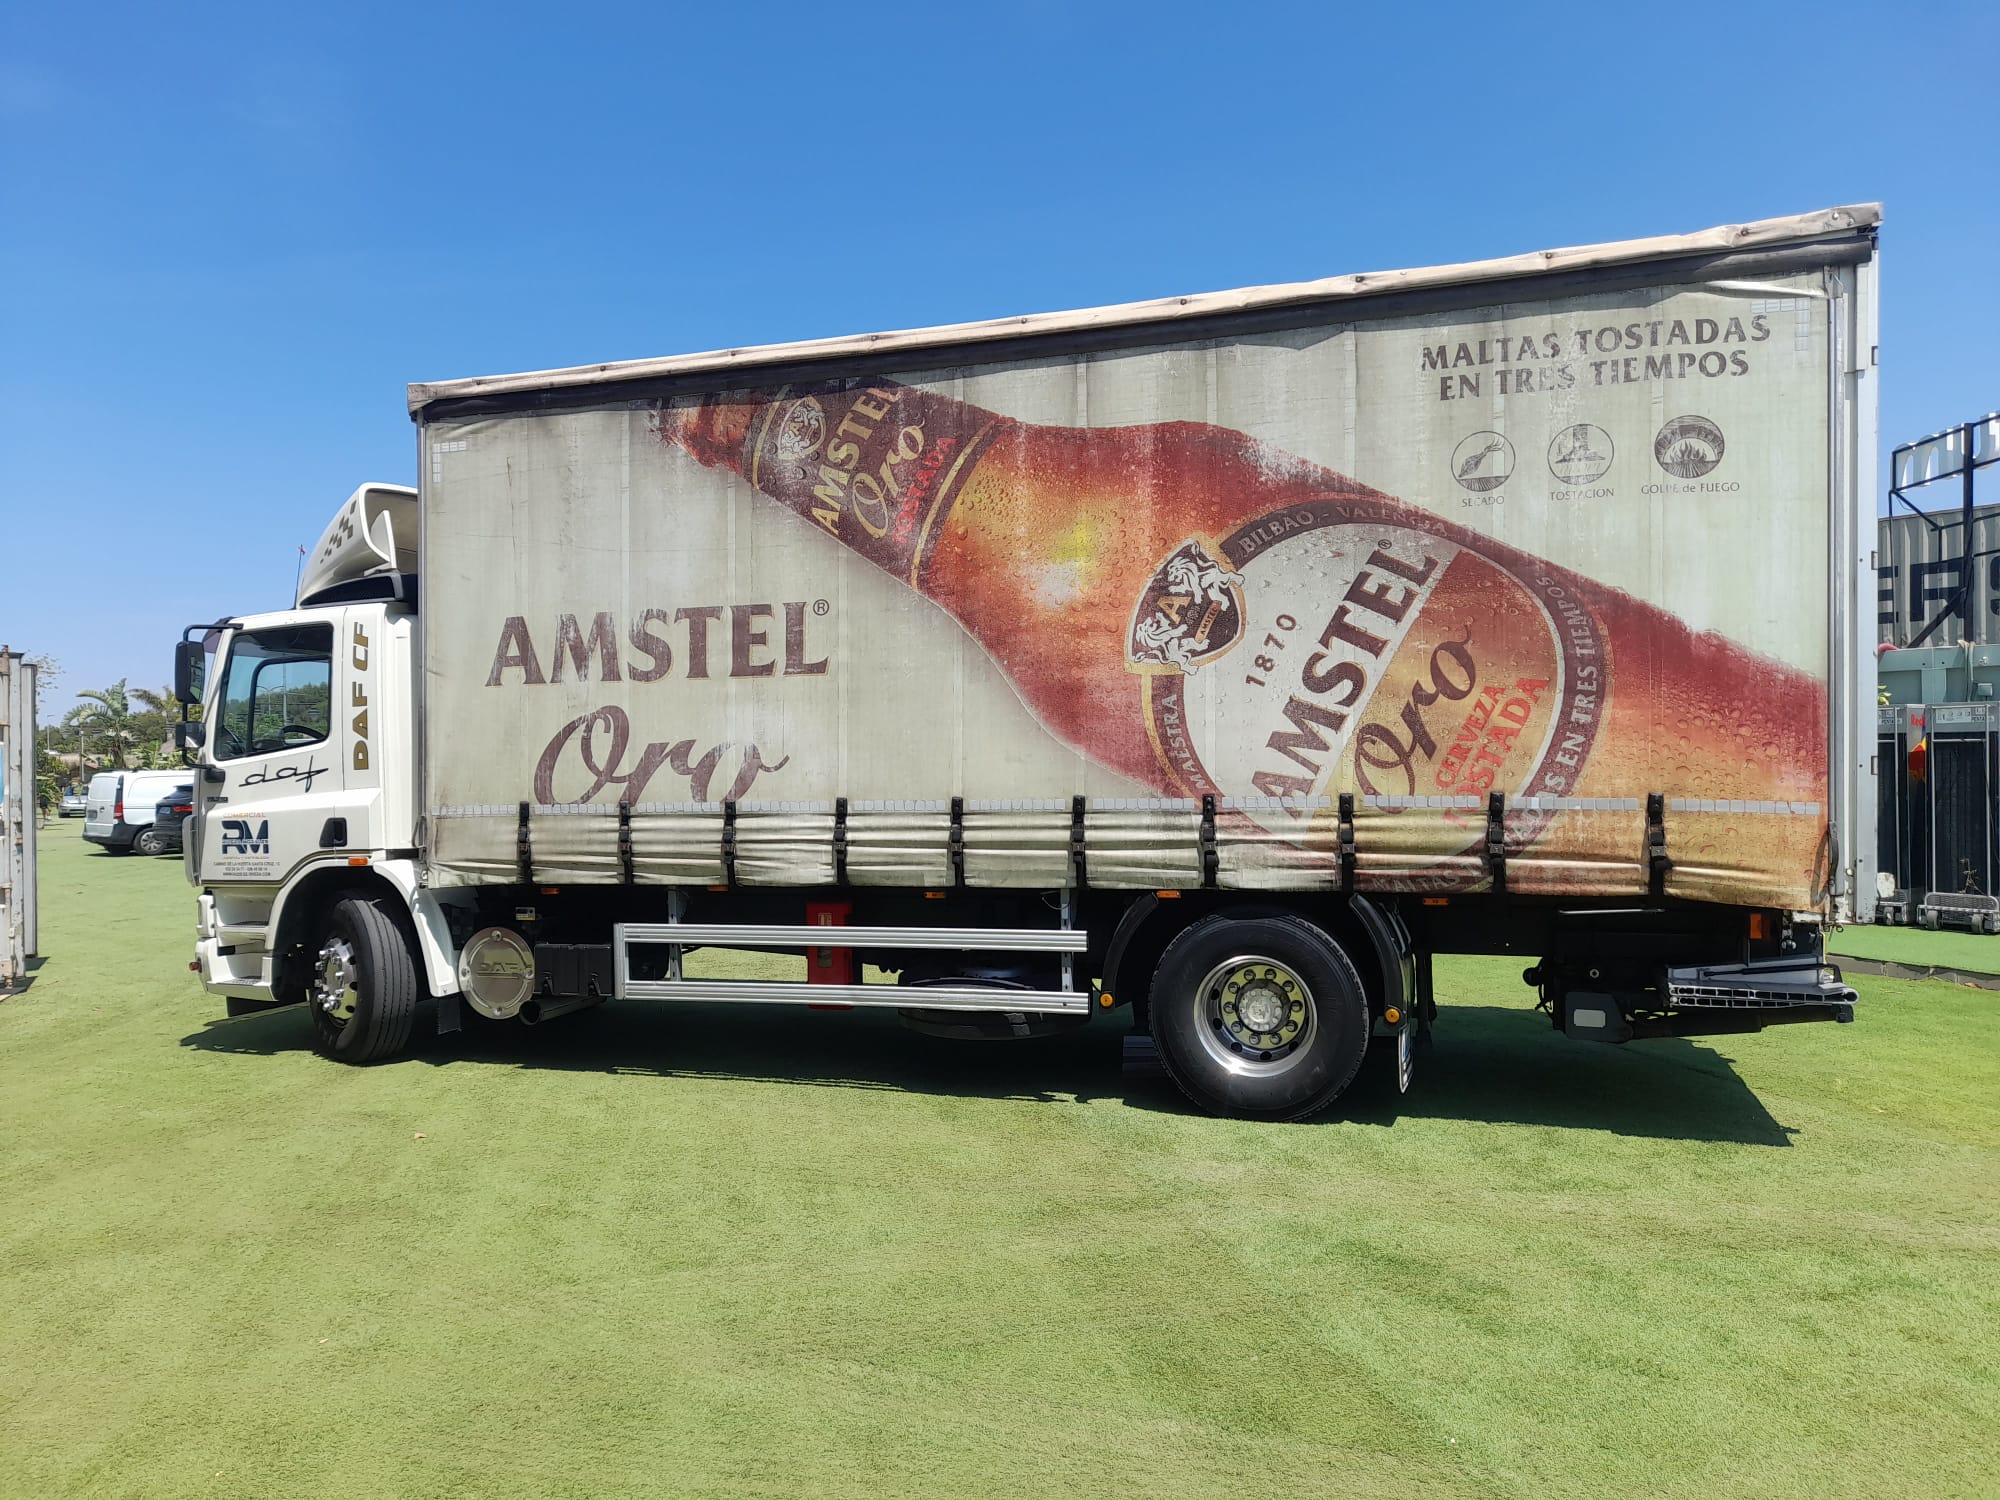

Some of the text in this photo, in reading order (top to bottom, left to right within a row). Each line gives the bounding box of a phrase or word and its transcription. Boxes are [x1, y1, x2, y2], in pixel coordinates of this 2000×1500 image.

[1422, 314, 1771, 372] MALTAS TOSTADAS
[1439, 349, 1749, 401] EN TRES TIEMPOS
[811, 387, 901, 536] AMSTEL
[893, 437, 959, 544] TOSTADA
[1682, 483, 1697, 493] de
[1700, 482, 1740, 493] FUEGO
[1238, 511, 1315, 558] BILBAO
[1200, 605, 1219, 636] AMSTEL
[1245, 613, 1298, 688] 1870
[352, 621, 369, 770] DAF CF
[1535, 576, 1598, 768] EN TRES TIEMPOS
[1161, 694, 1210, 790] MAESTRA
[1355, 624, 1476, 814] Oro
[1435, 685, 1505, 788] CERVEZA
[239, 755, 328, 793] daf
[221, 819, 269, 854] RM
